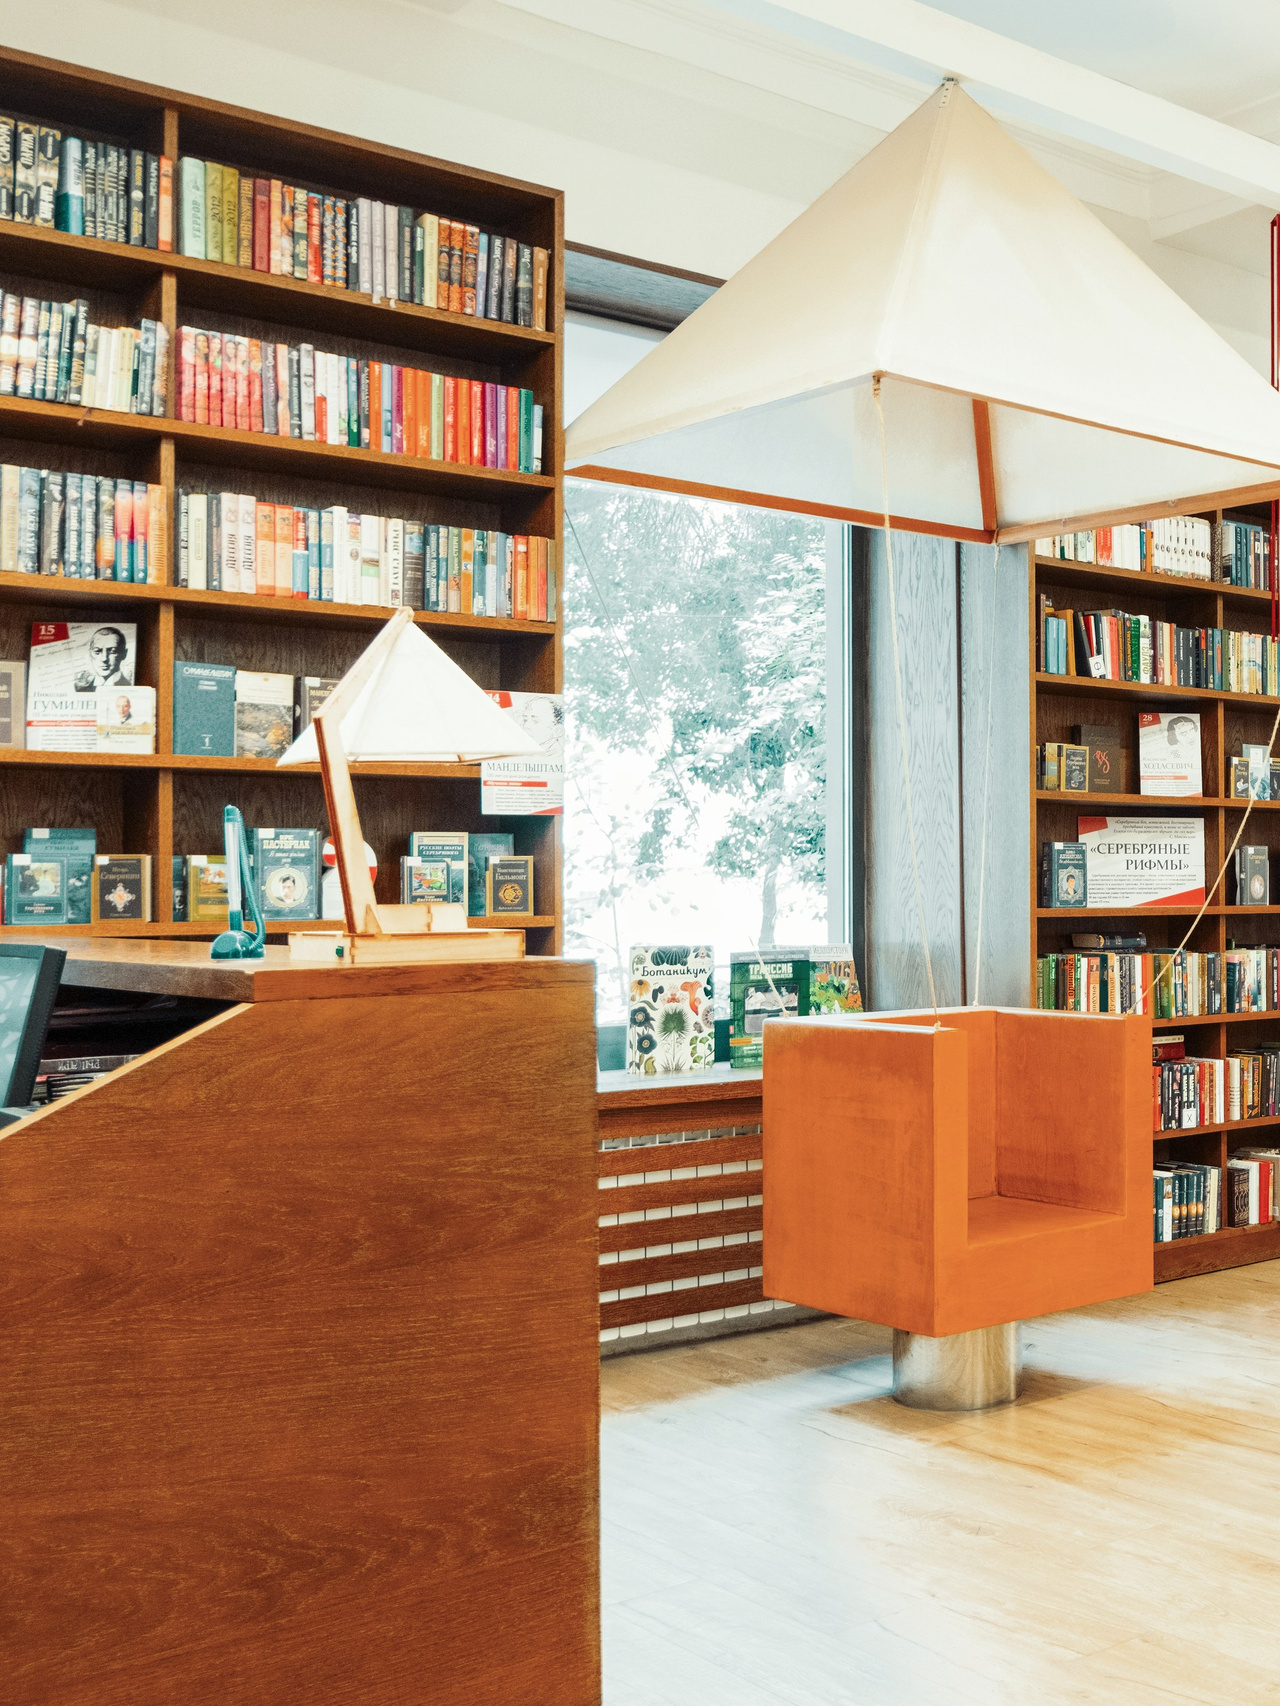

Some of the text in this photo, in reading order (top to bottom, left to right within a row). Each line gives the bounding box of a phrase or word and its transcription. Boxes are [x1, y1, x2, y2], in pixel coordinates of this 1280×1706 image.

[39, 625, 55, 635] 15
[487, 762, 563, 773] МАНДЕЛЬШТАМ
[1143, 762, 1194, 770] ХОДАСЕВИЧ
[263, 840, 310, 849] ПАСТЕРНАК
[1090, 843, 1190, 855] «СЕРЕБРЯНЫЕ
[1126, 859, 1190, 871] РИФМЫ»
[641, 965, 708, 978] Ботаникум
